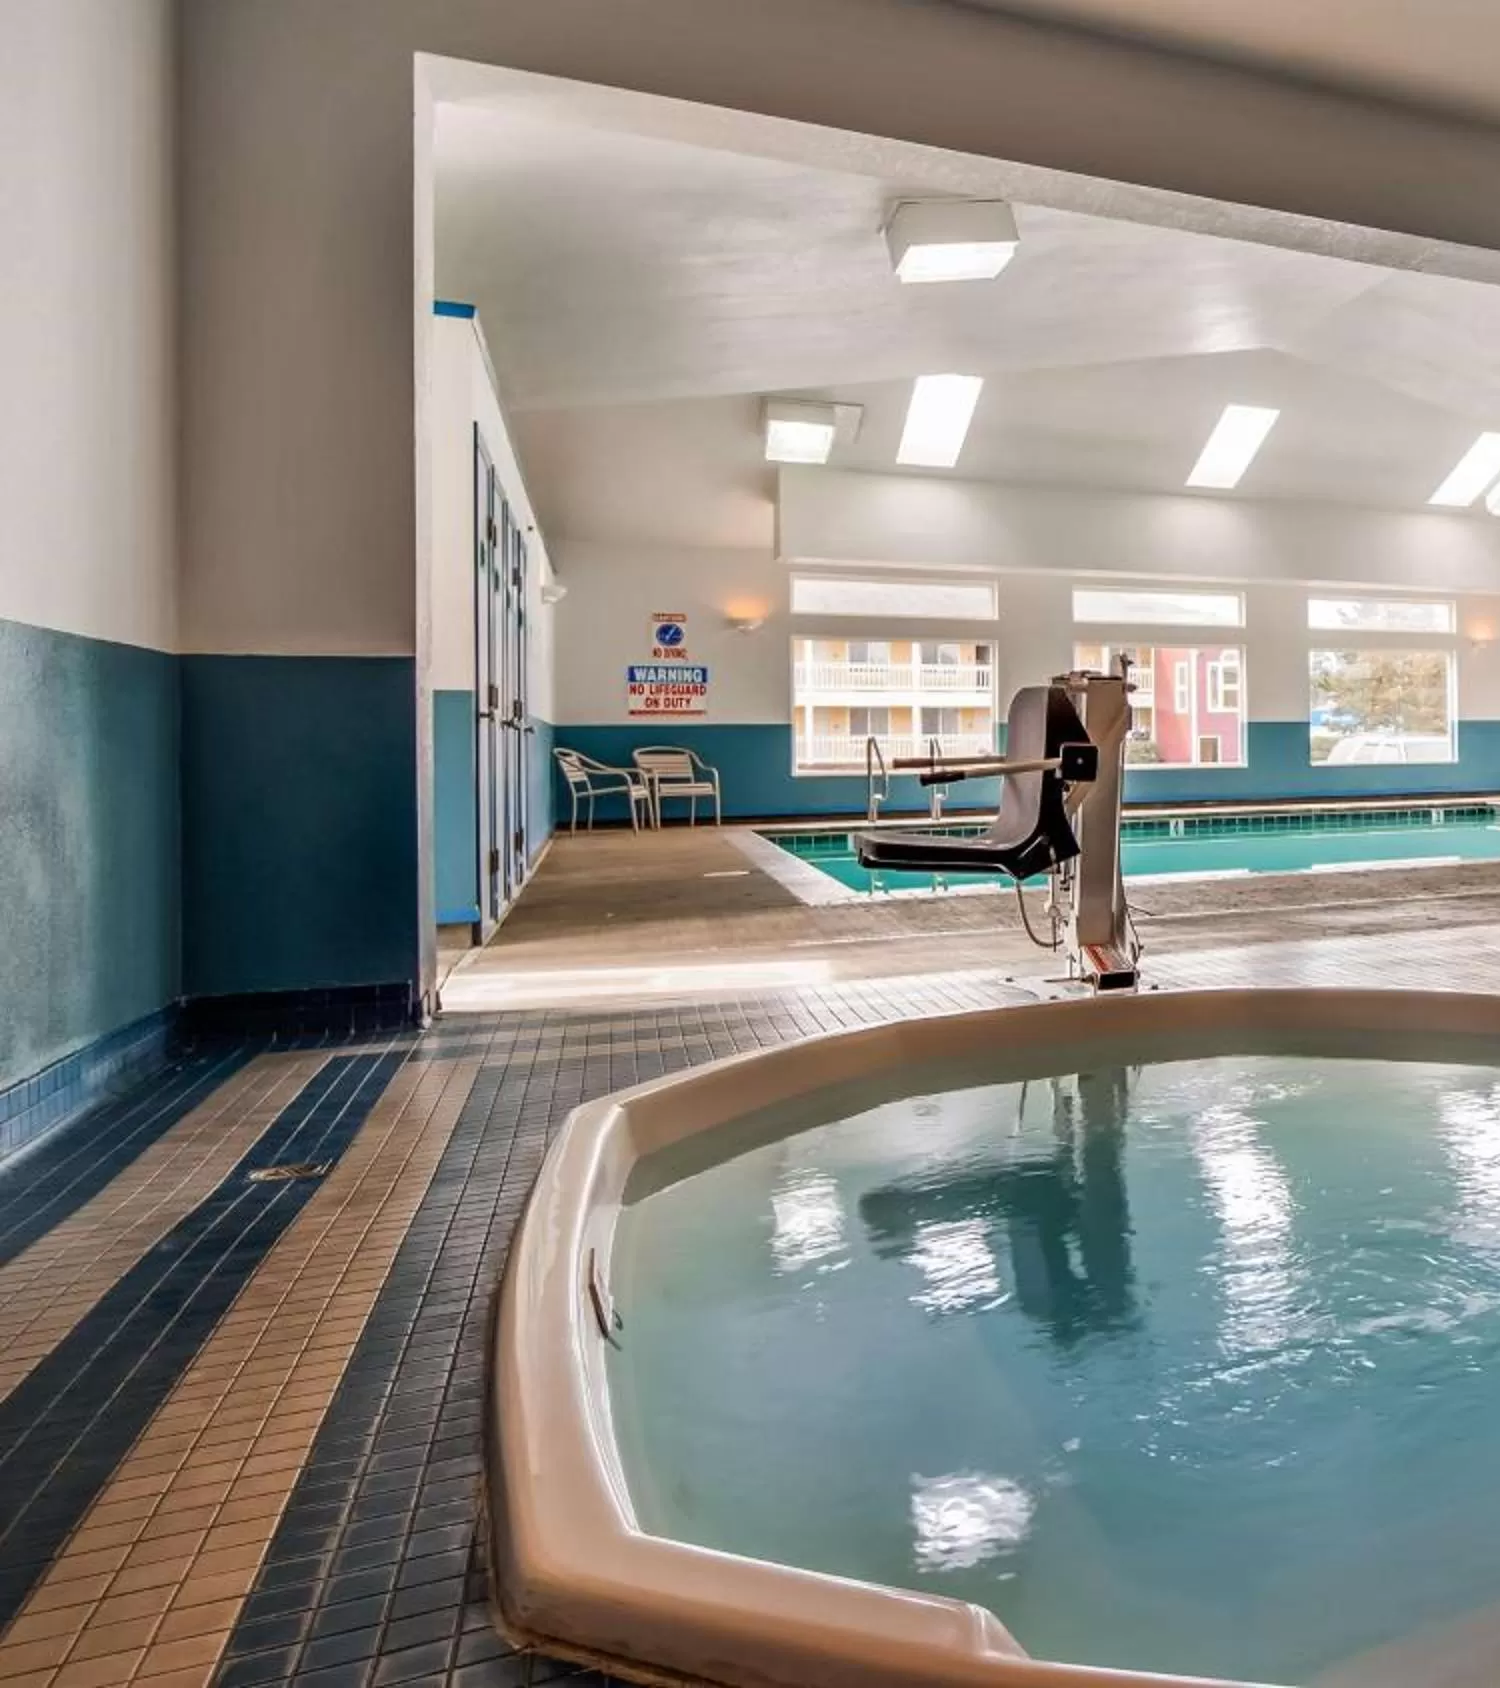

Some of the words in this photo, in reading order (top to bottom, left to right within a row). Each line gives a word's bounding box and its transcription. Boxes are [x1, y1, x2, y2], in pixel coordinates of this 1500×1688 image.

[635, 667, 703, 682] WARNING
[629, 684, 645, 696] NO
[649, 684, 707, 696] LIFEGUARD
[645, 697, 660, 708] ON
[664, 697, 692, 708] DUTY
